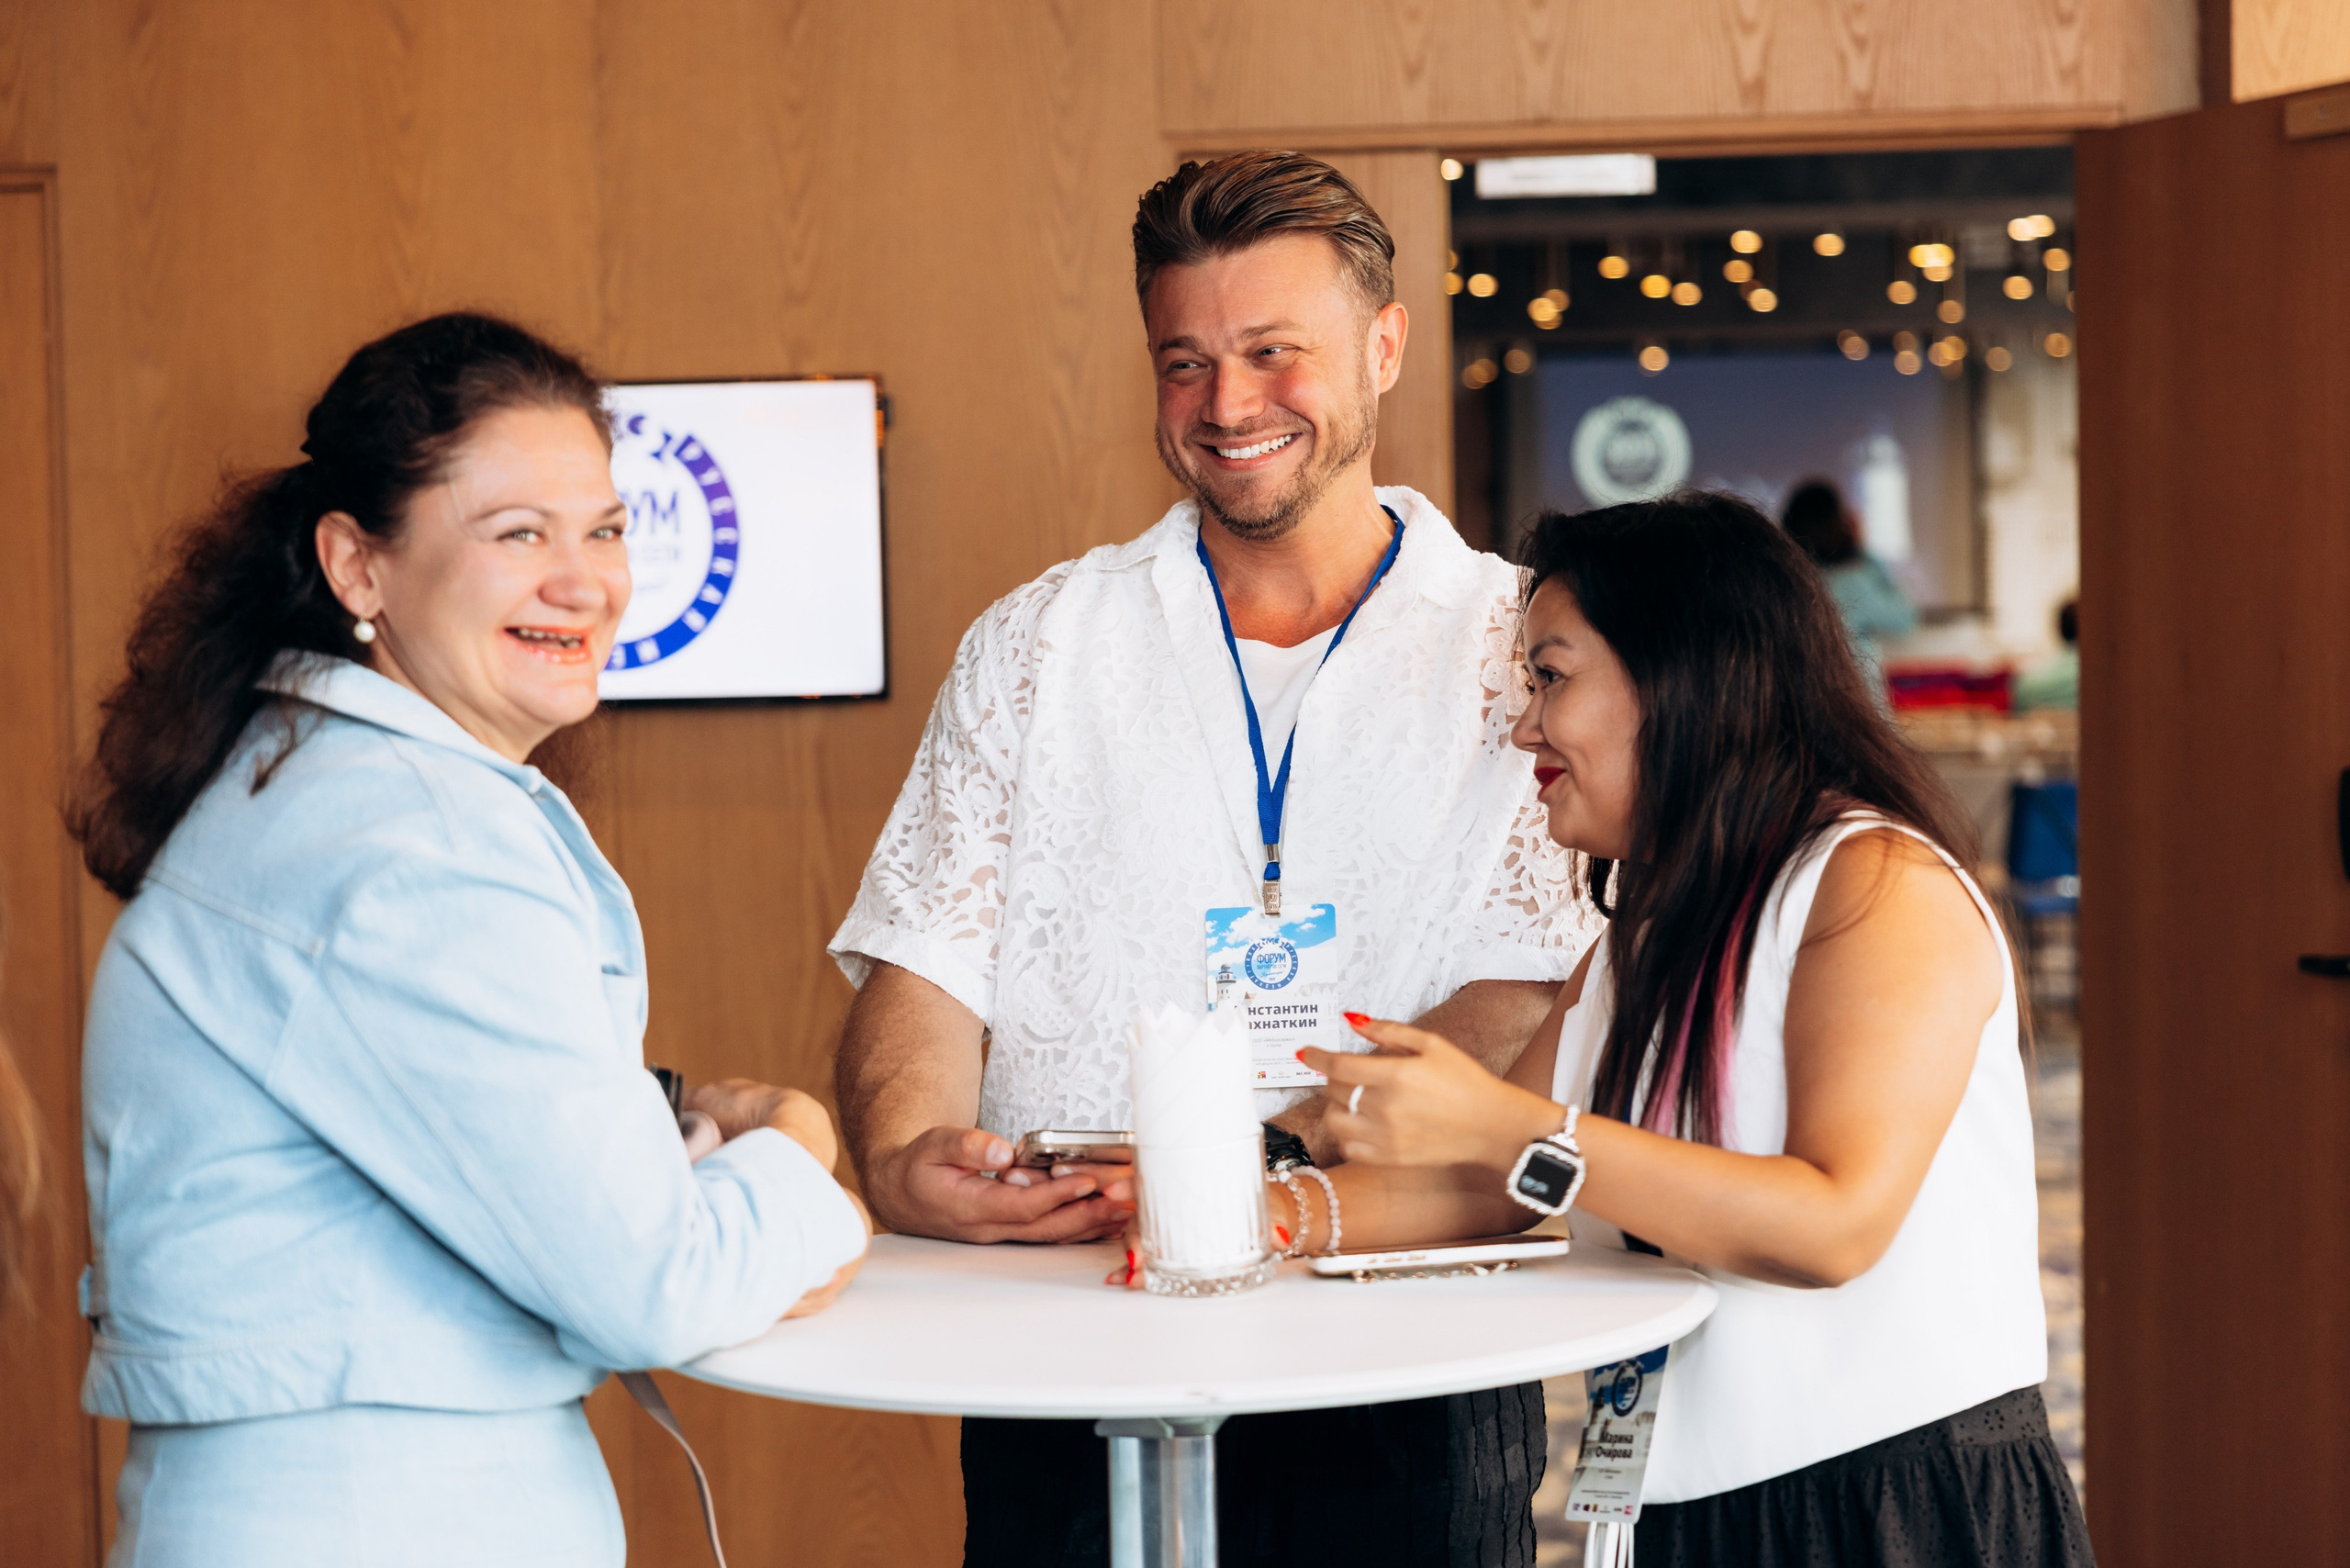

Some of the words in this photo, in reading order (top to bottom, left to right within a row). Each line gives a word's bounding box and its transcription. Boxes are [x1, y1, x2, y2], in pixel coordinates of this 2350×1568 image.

[617, 488, 680, 537] УМ
[1257, 953, 1286, 964] ФОРУМ
[1248, 1004, 1318, 1015] нстантин
[1599, 1431, 1633, 1447] Марина
[1595, 1446, 1632, 1462] Очирова
